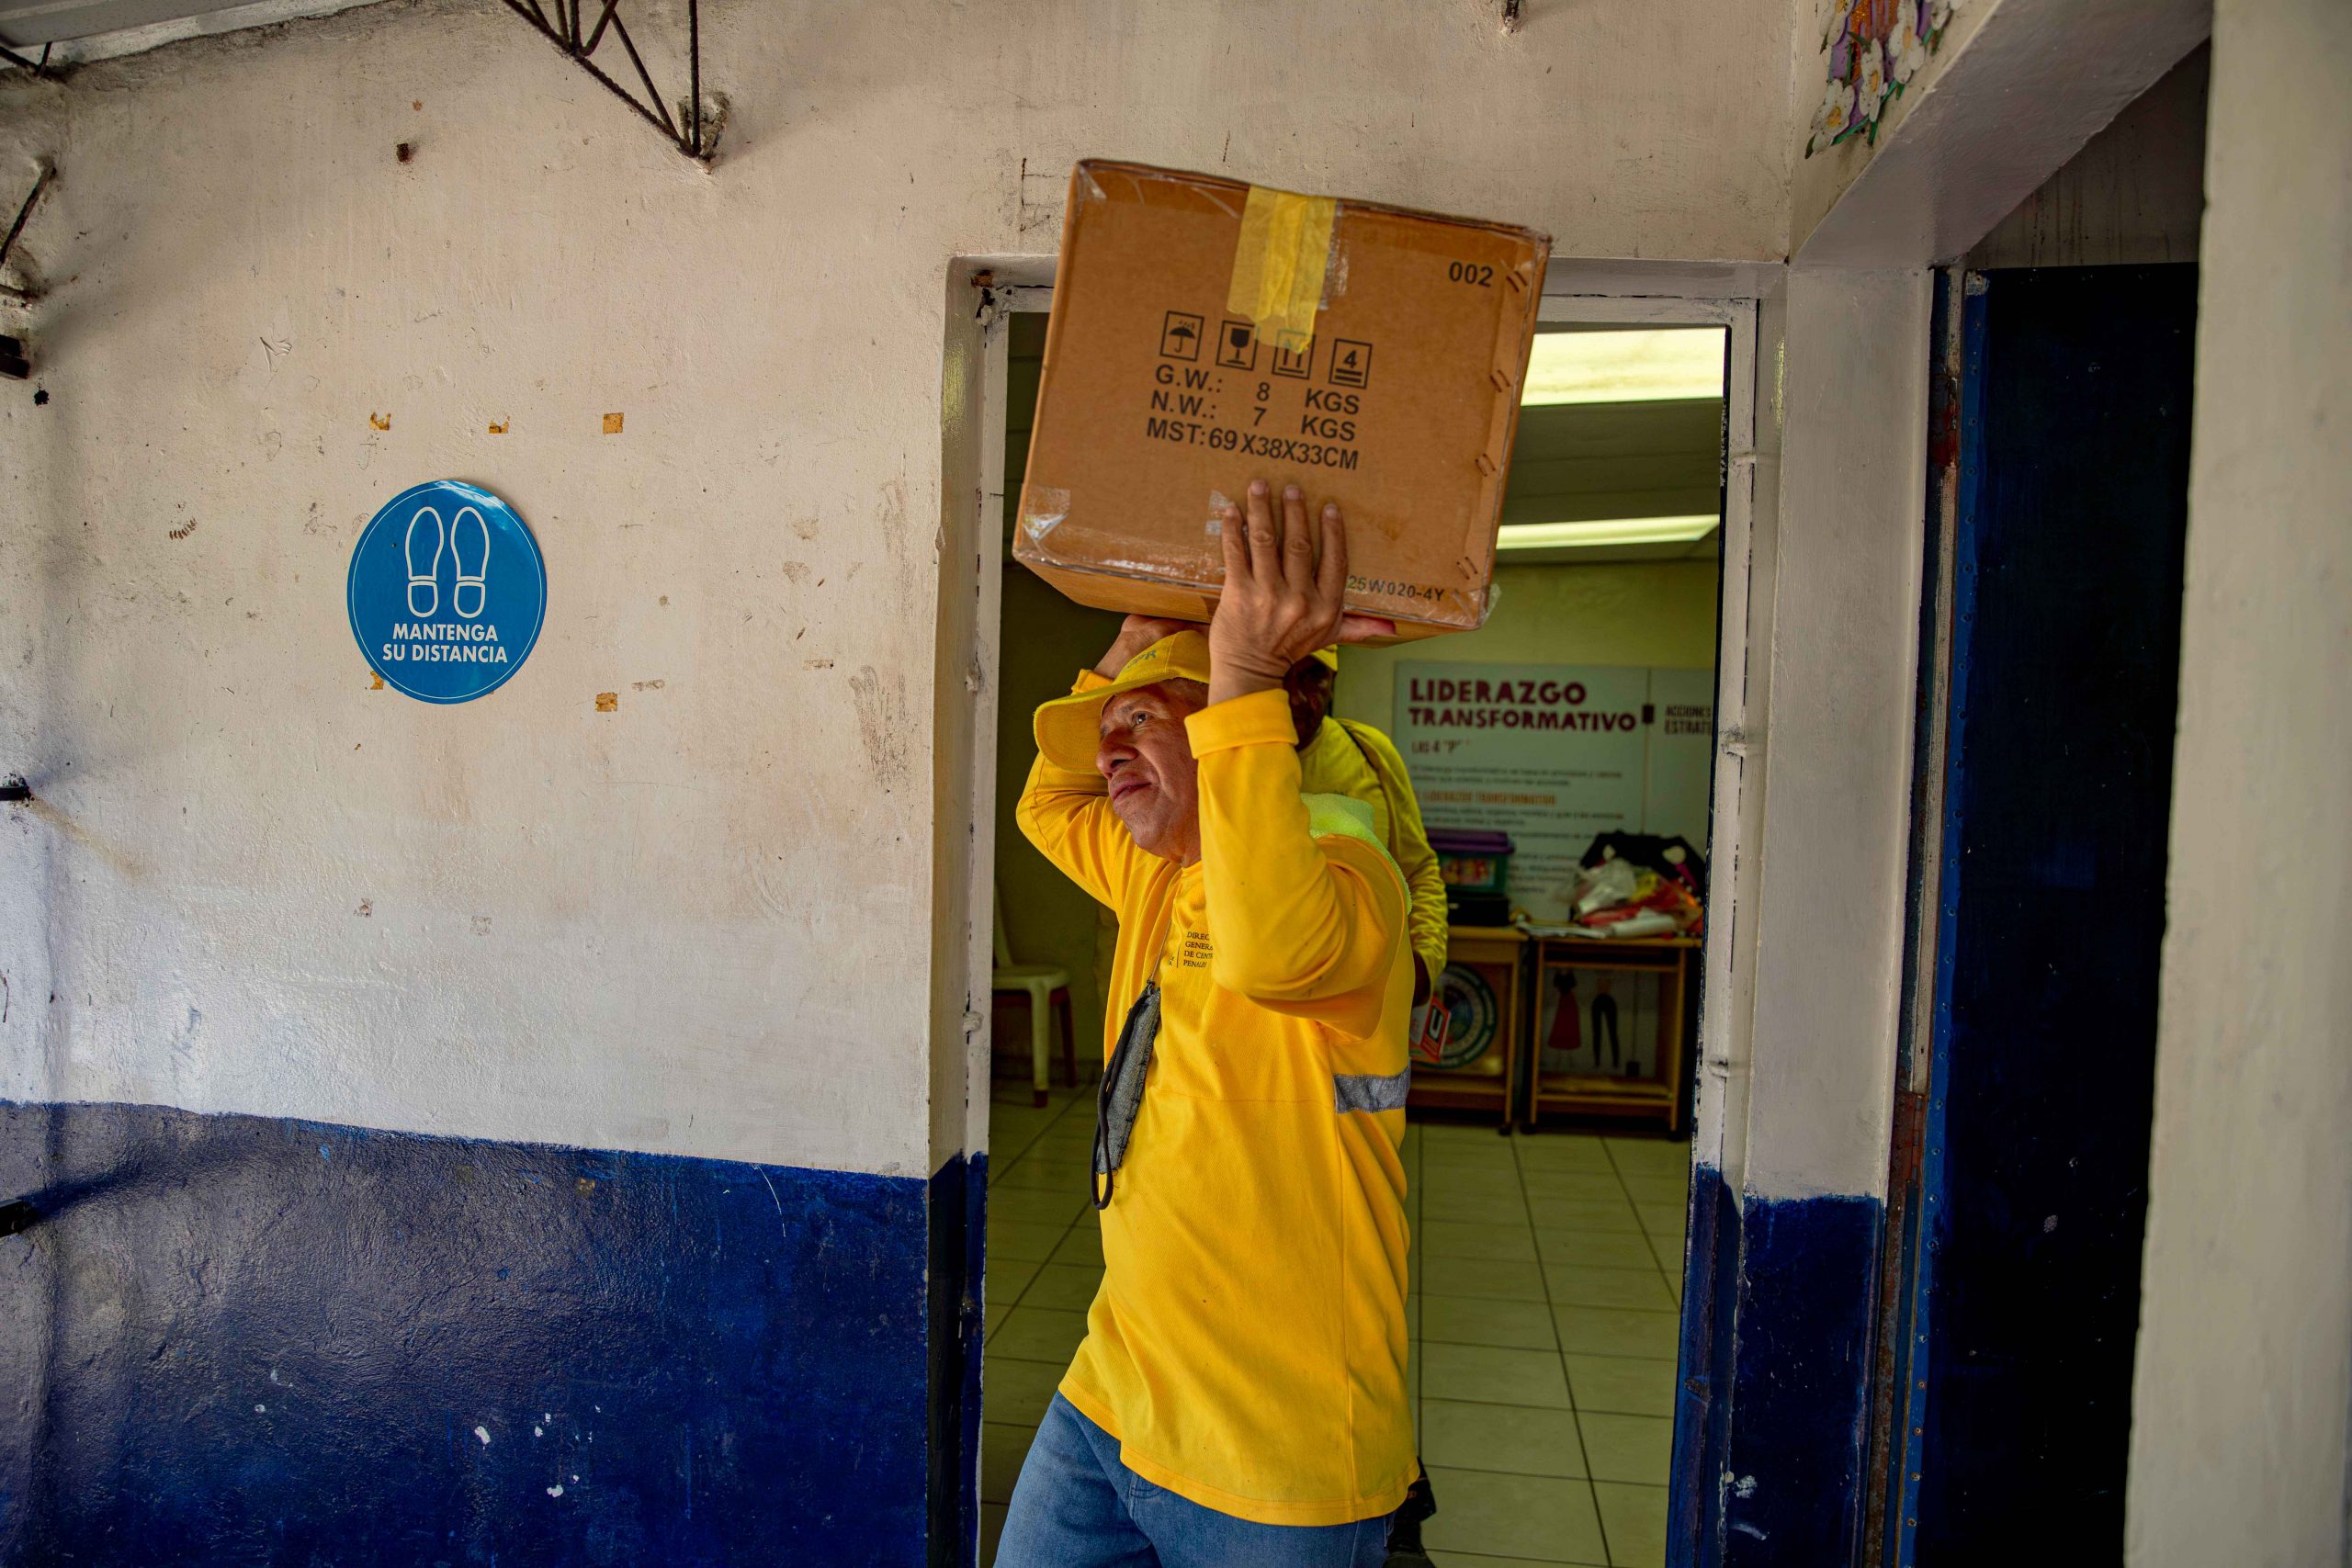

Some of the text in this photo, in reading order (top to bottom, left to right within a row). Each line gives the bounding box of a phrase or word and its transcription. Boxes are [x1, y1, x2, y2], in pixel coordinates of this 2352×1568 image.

[1449, 261, 1493, 288] 002
[1155, 364, 1360, 414] G.W.: 8 KGS
[1150, 389, 1356, 441] N.W.: 7 KGS
[392, 623, 498, 642] MANTENGA
[382, 644, 508, 663] SU DISTANCIA
[1409, 678, 1587, 705] LIDERAZGO
[1408, 707, 1637, 732] TRANSFORMATIVO
